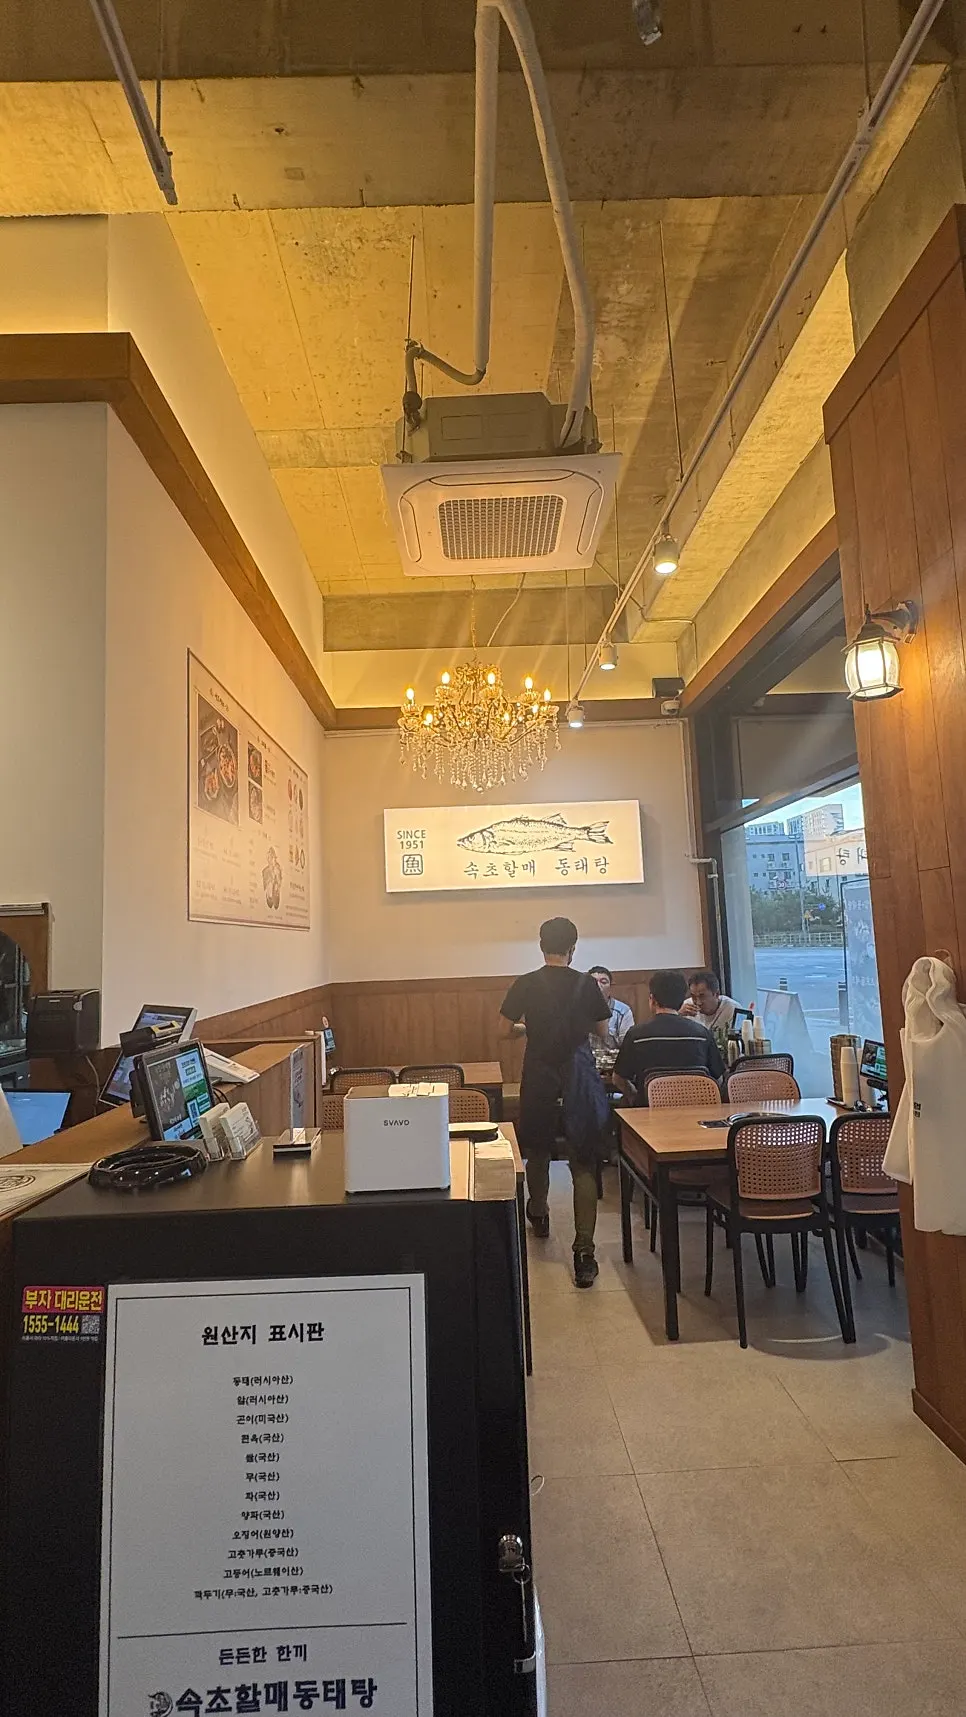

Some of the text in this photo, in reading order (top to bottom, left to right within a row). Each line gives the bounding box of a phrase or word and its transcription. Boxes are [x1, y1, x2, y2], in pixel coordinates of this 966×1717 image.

[397, 829, 426, 839] SINCE
[400, 840, 424, 849] 1951
[405, 856, 421, 872] 魚
[463, 856, 609, 879] 속초할매 동태탕
[25, 1290, 102, 1311] 부자 대리운전
[23, 1315, 79, 1333] 1555-1444
[202, 1322, 324, 1345] 원산지 표시판
[232, 1375, 293, 1387] 동태(러시아산)
[237, 1394, 289, 1405] 알(러시아산)
[236, 1413, 289, 1424] 곤이(미국산)
[245, 1452, 280, 1463] 쌀(국산)
[245, 1471, 280, 1482] 무(국산)
[245, 1490, 280, 1501] 파(국산)
[241, 1509, 285, 1521] 양파(국산)
[232, 1528, 294, 1540] 오징어(원양산)
[228, 1547, 299, 1559] 고춧가루(중국산)
[223, 1566, 304, 1579] 고등어(노르웨이산)
[218, 1644, 308, 1665] 든든한 한끼
[175, 1678, 378, 1717] 속초할매동태탕
